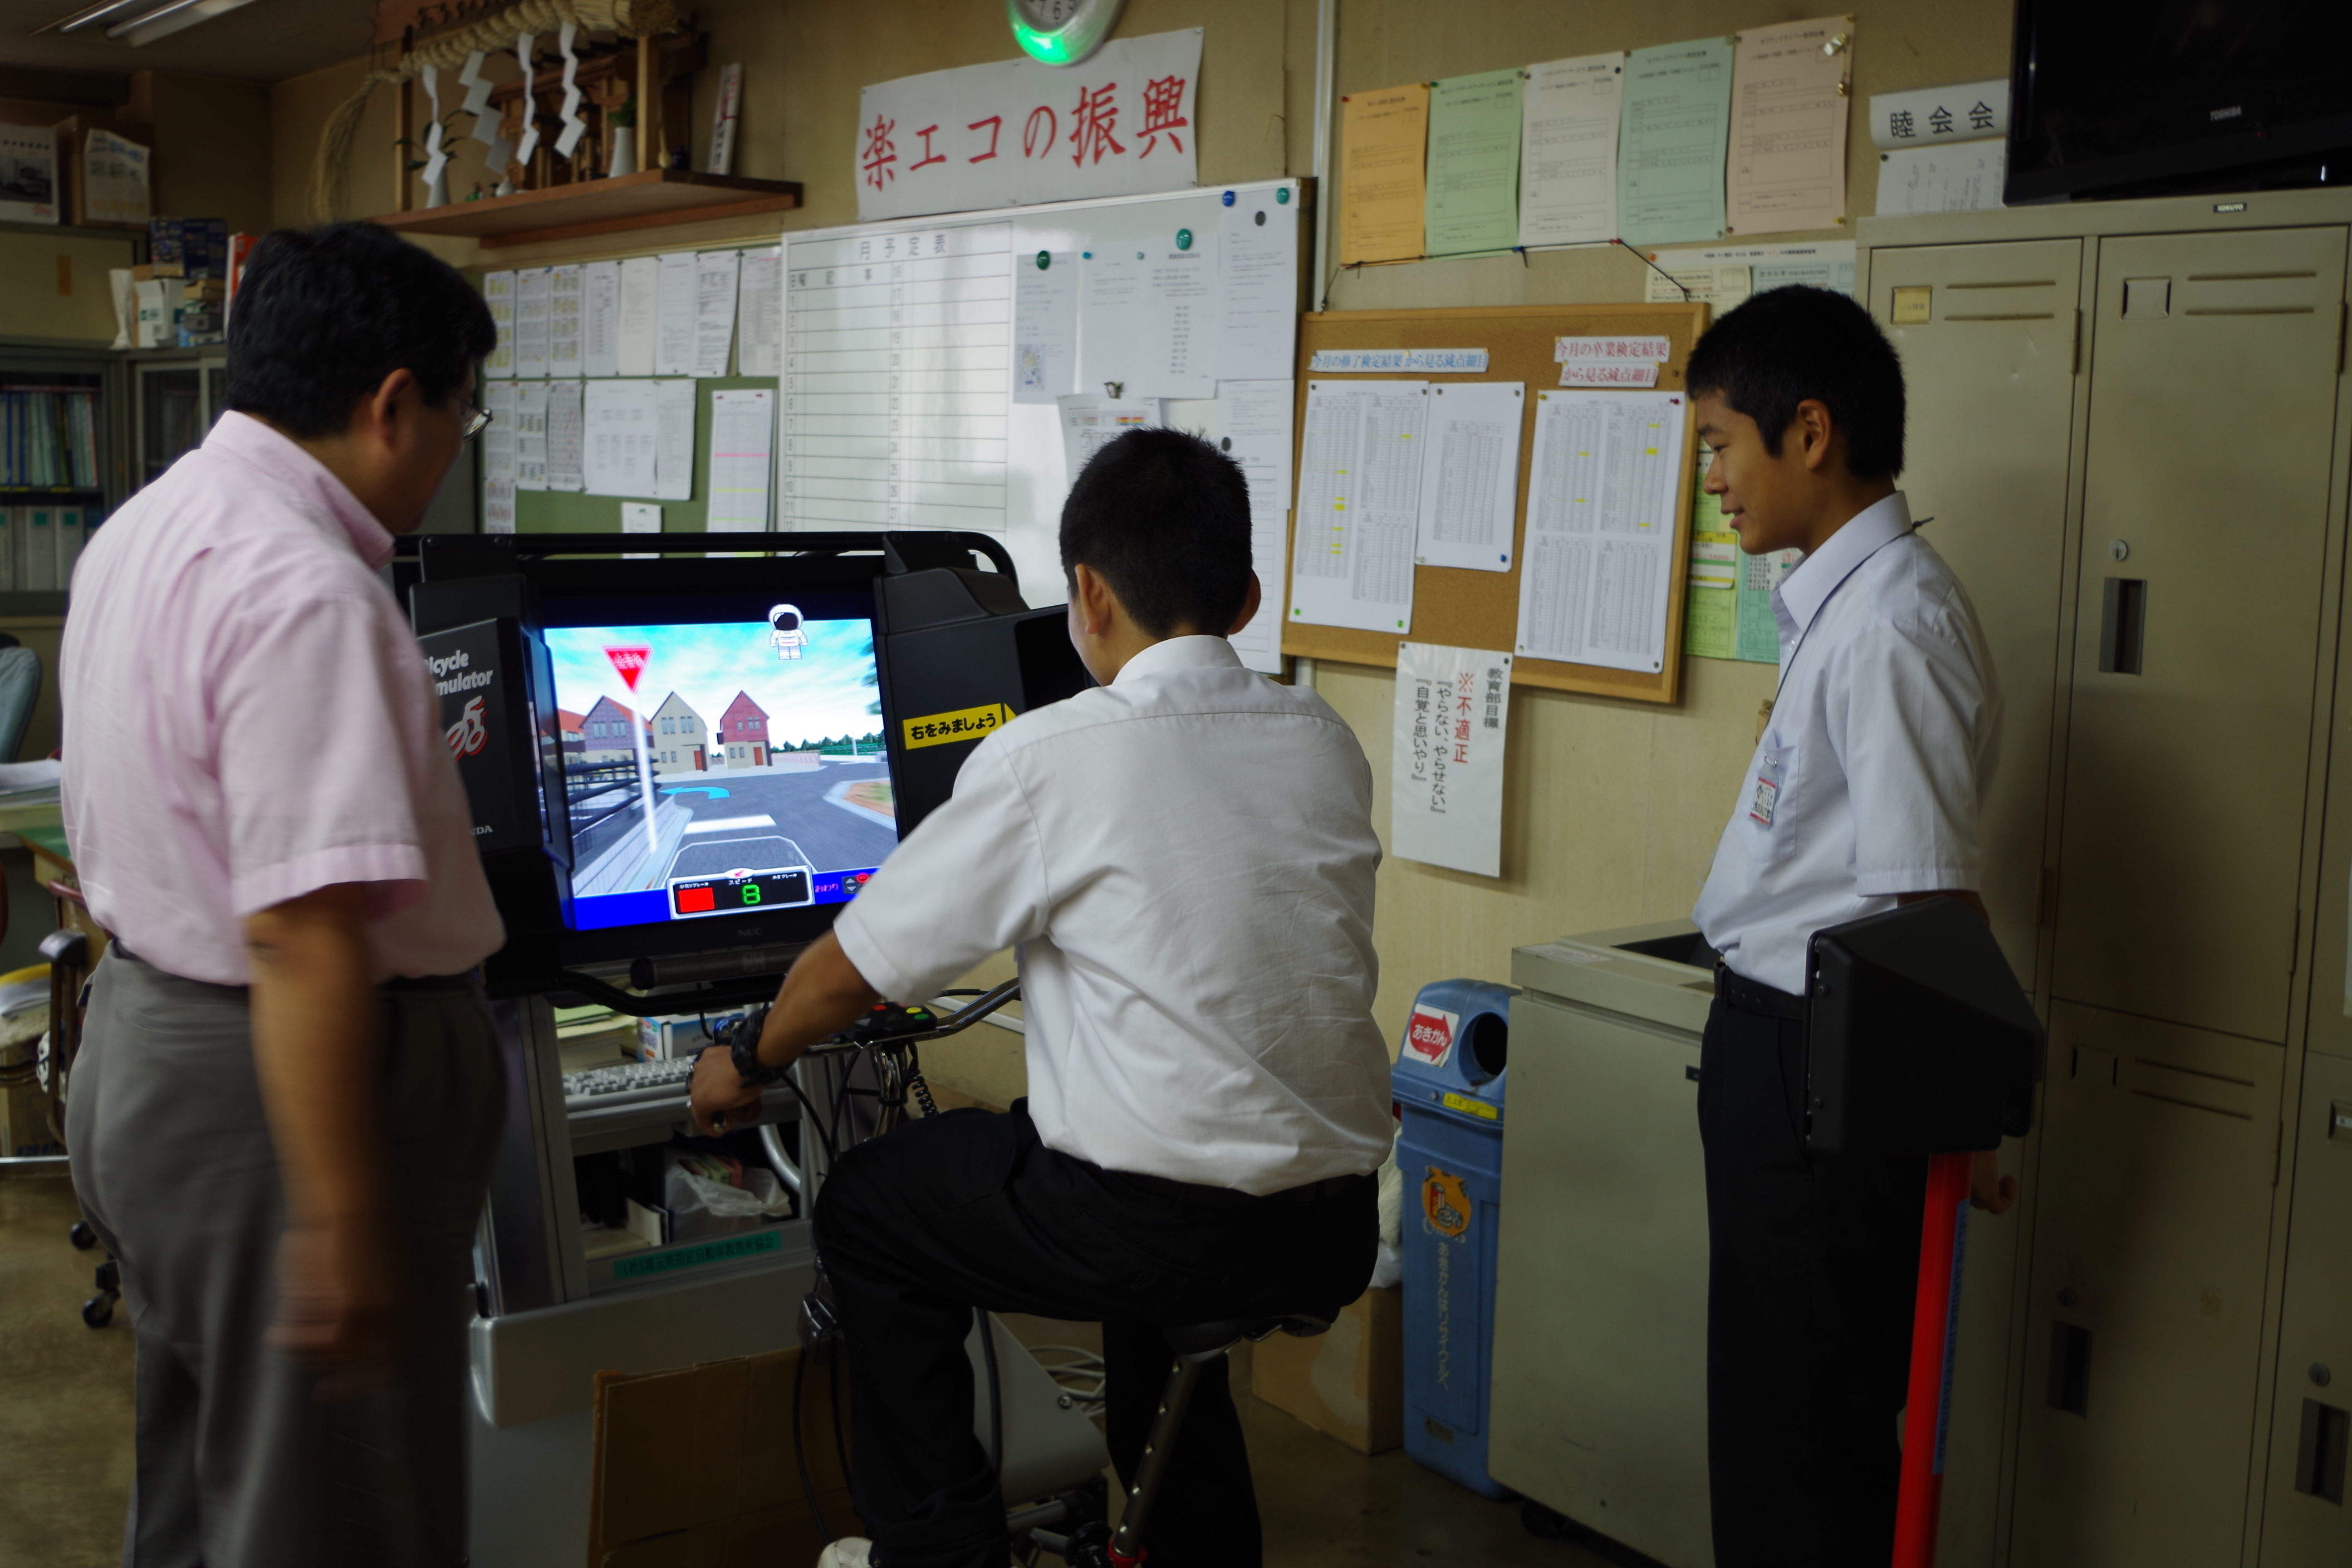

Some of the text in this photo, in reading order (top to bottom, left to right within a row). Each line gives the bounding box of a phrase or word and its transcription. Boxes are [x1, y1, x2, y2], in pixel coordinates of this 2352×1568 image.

[1054, 1, 1061, 19] 6
[1890, 101, 1994, 138] 睦会会
[2209, 105, 2242, 121] TOSHIBA
[861, 74, 1189, 193] 楽エコの振興
[2217, 203, 2244, 213] KOKUYO
[1557, 341, 1667, 357] 今月の卒業検定結果
[1313, 353, 1487, 368] 今月の修了検定結果 から見る減点細目
[1562, 367, 1658, 382] から見る減点細目
[433, 670, 494, 697] mulator
[1483, 667, 1503, 729] 教育部目標
[910, 713, 997, 741] 右をみましょう
[1411, 678, 1432, 782] 『自覚と思いやり』
[1430, 680, 1452, 814] 『やらない、やらせない』
[471, 825, 493, 836] NDA
[742, 884, 761, 905] 8
[815, 883, 839, 893] おわり
[738, 927, 763, 937] NEC
[1412, 1023, 1448, 1047] あきかん
